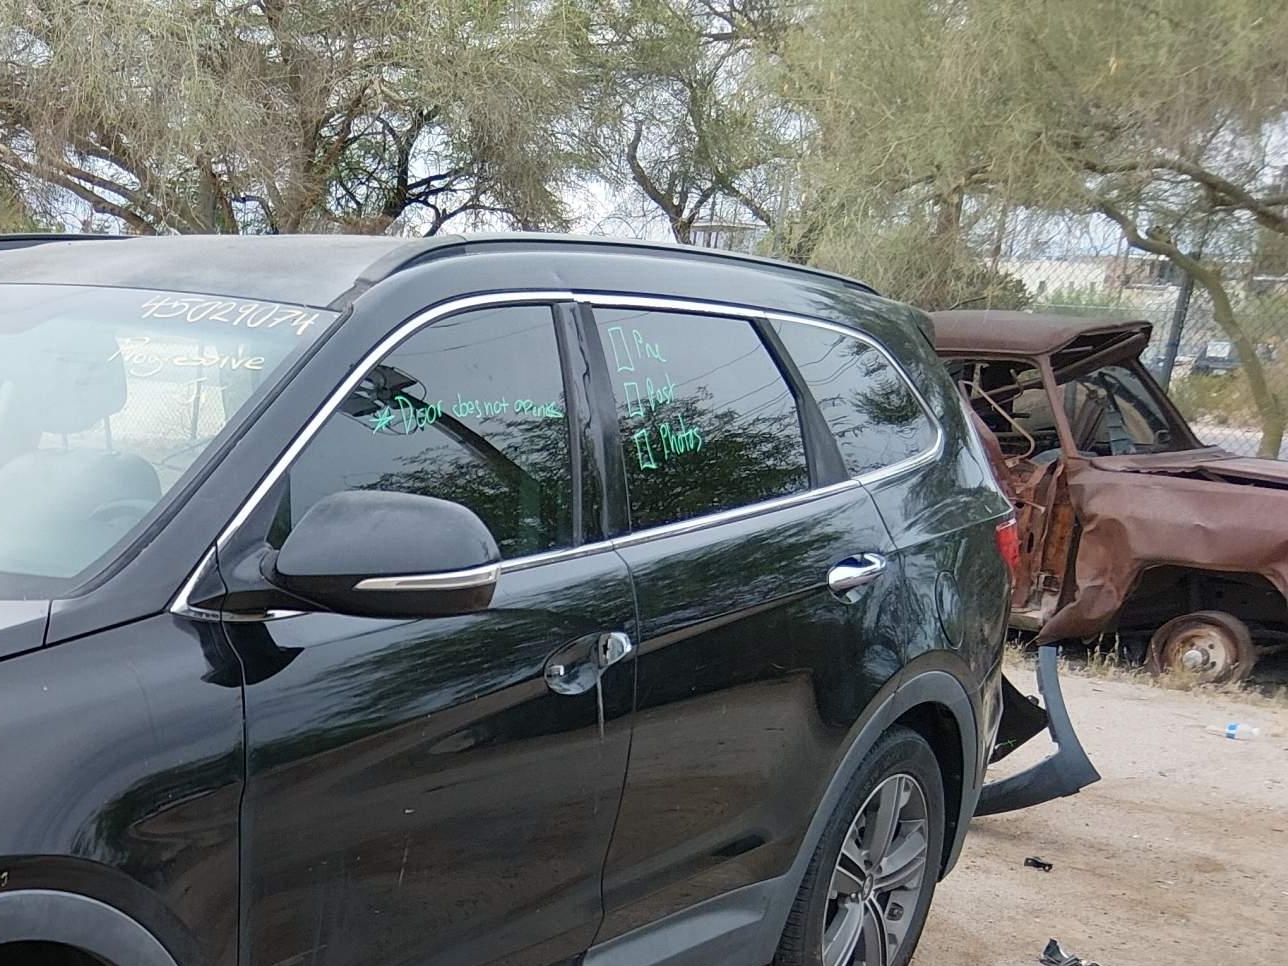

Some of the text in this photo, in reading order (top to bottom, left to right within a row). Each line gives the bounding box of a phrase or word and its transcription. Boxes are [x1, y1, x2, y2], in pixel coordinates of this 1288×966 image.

[141, 295, 320, 336] 45029074
[394, 395, 444, 435] Door
[485, 396, 510, 416] not
[659, 413, 703, 461] Photos
